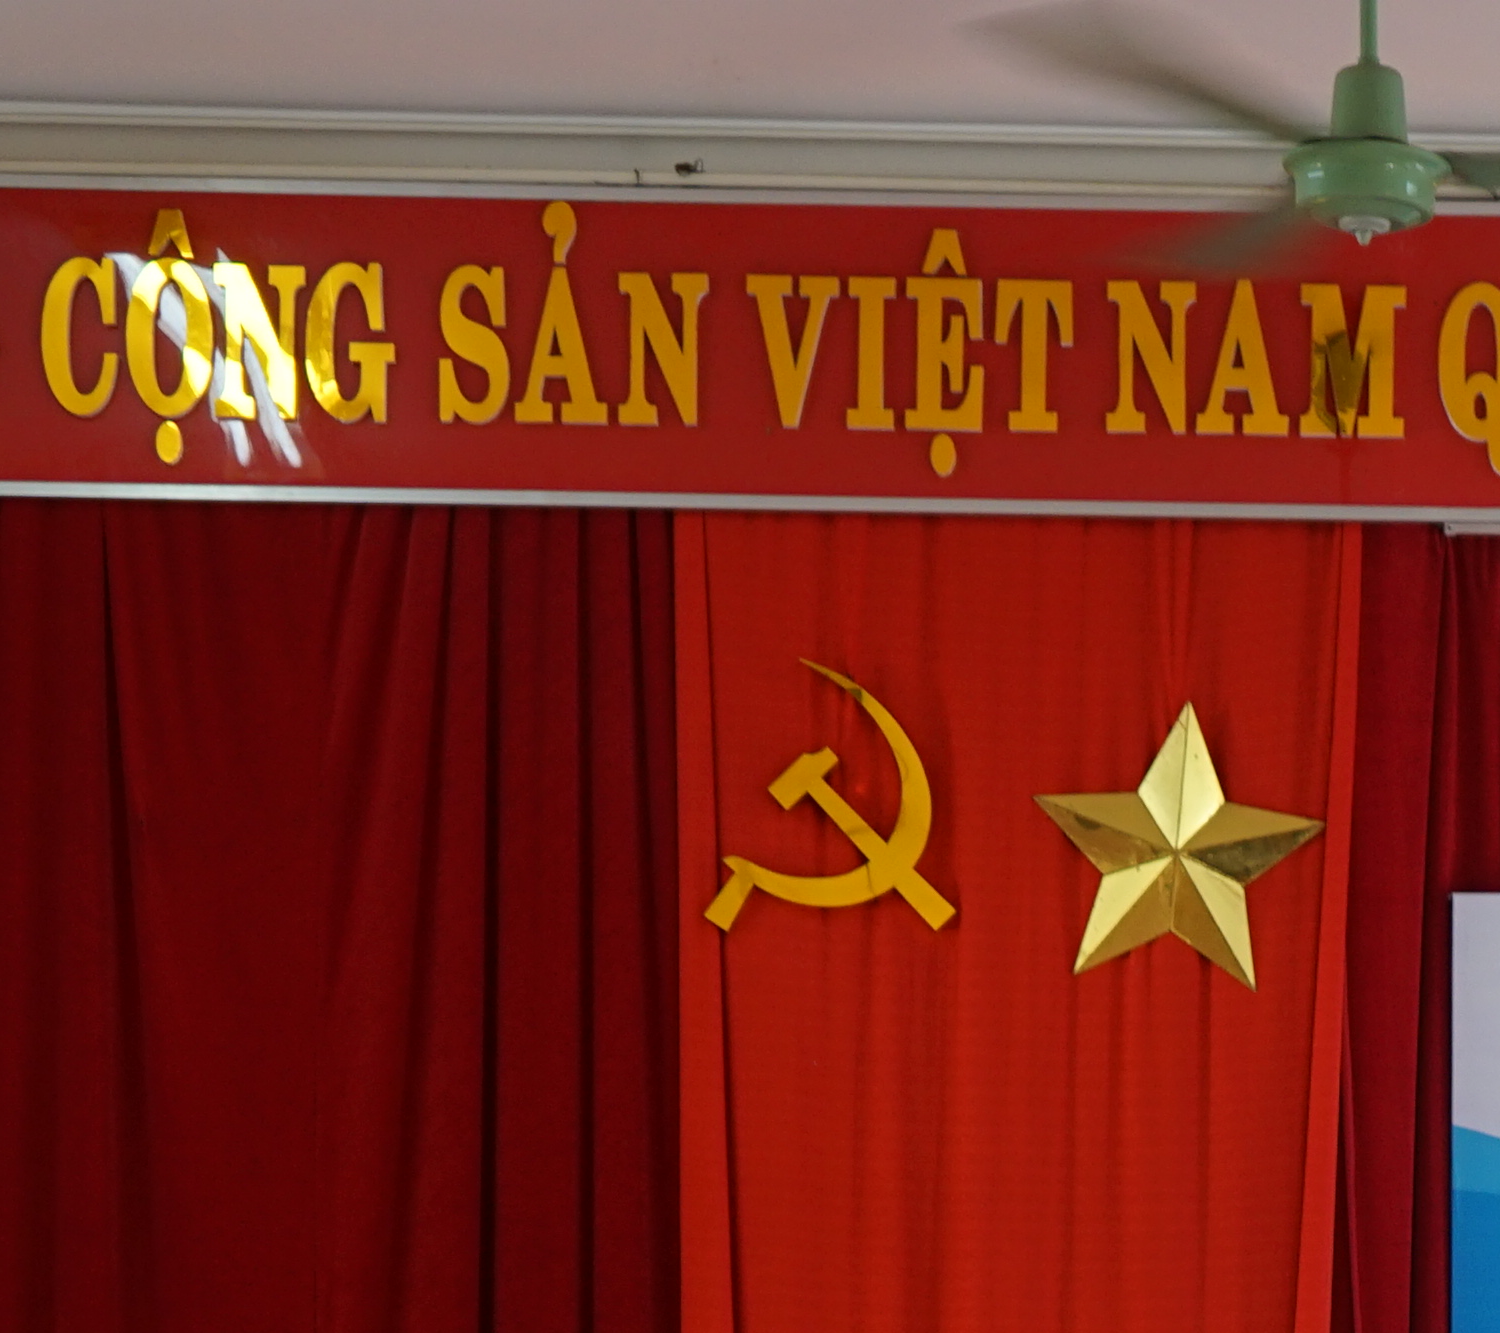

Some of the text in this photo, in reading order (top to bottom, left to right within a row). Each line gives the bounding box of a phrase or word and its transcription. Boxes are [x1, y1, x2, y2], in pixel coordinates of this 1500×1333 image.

[41, 208, 396, 464] CỘNG
[439, 205, 708, 426] SẢN
[747, 229, 1073, 478] VIỆT
[1107, 279, 1405, 438] NAM
